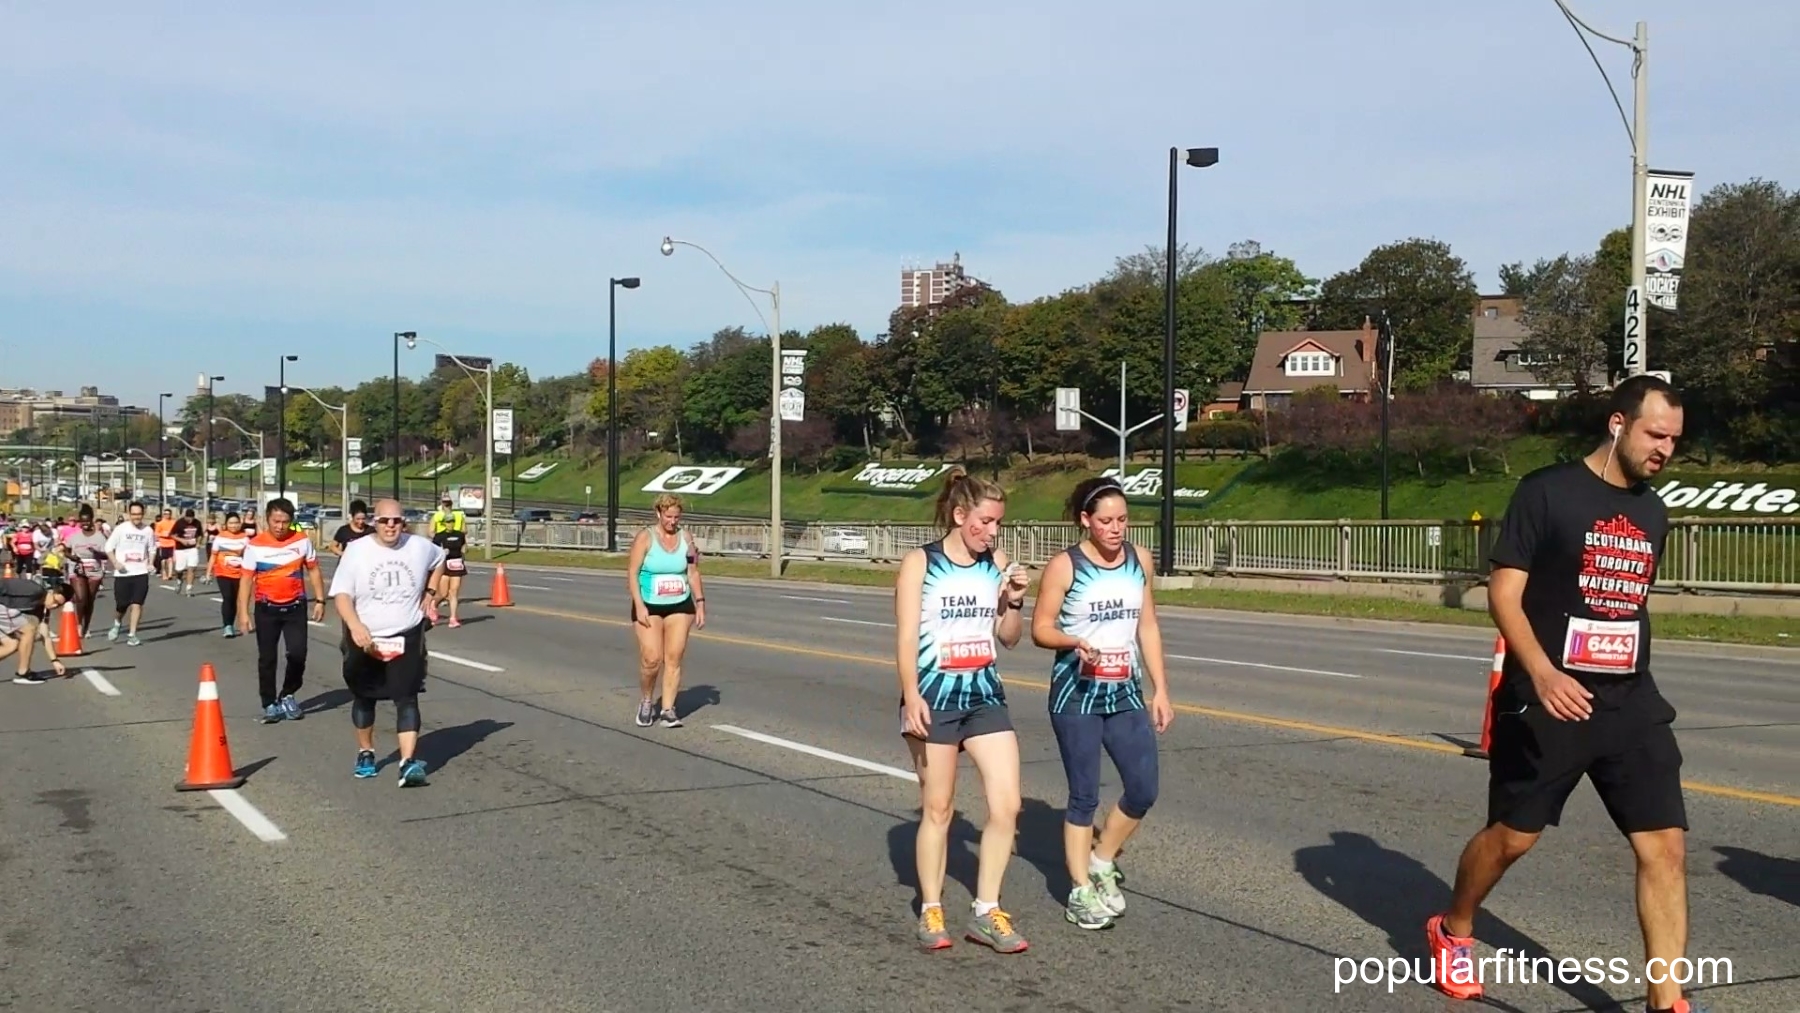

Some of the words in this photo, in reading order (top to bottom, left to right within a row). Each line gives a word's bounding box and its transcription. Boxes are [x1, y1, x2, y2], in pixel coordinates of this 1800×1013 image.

[1651, 183, 1687, 200] NHL
[1647, 206, 1686, 218] EXHIBIT
[1625, 289, 1640, 366] 422
[853, 462, 936, 486] Tangerine
[1100, 468, 1164, 496] dEx
[1655, 480, 1800, 513] loitte.
[1585, 531, 1653, 554] SCOTIABANK
[1595, 554, 1645, 574] TORONTO
[1578, 574, 1650, 596] WATERFRONT
[941, 595, 977, 607] TEAM
[1089, 598, 1124, 611] TEAM
[941, 607, 995, 620] DIABETES
[1089, 608, 1141, 624] DIABETES
[1587, 635, 1634, 653] 6443
